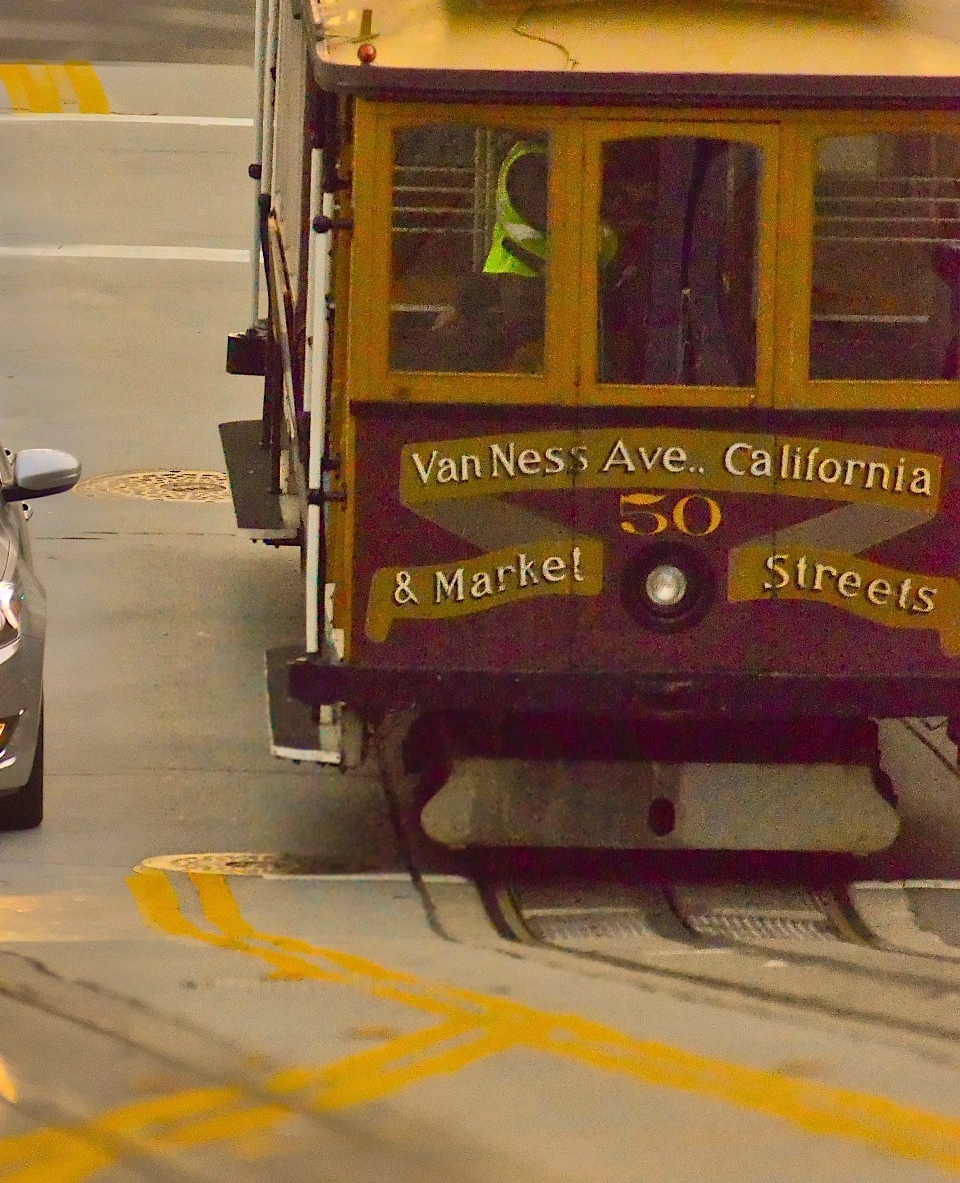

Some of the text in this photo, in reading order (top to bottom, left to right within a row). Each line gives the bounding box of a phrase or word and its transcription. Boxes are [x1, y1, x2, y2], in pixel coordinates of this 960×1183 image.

[412, 449, 483, 484] Van
[490, 442, 589, 477] Ness
[724, 442, 932, 496] California
[619, 492, 722, 536] 50
[394, 546, 938, 613] & Market Streets
